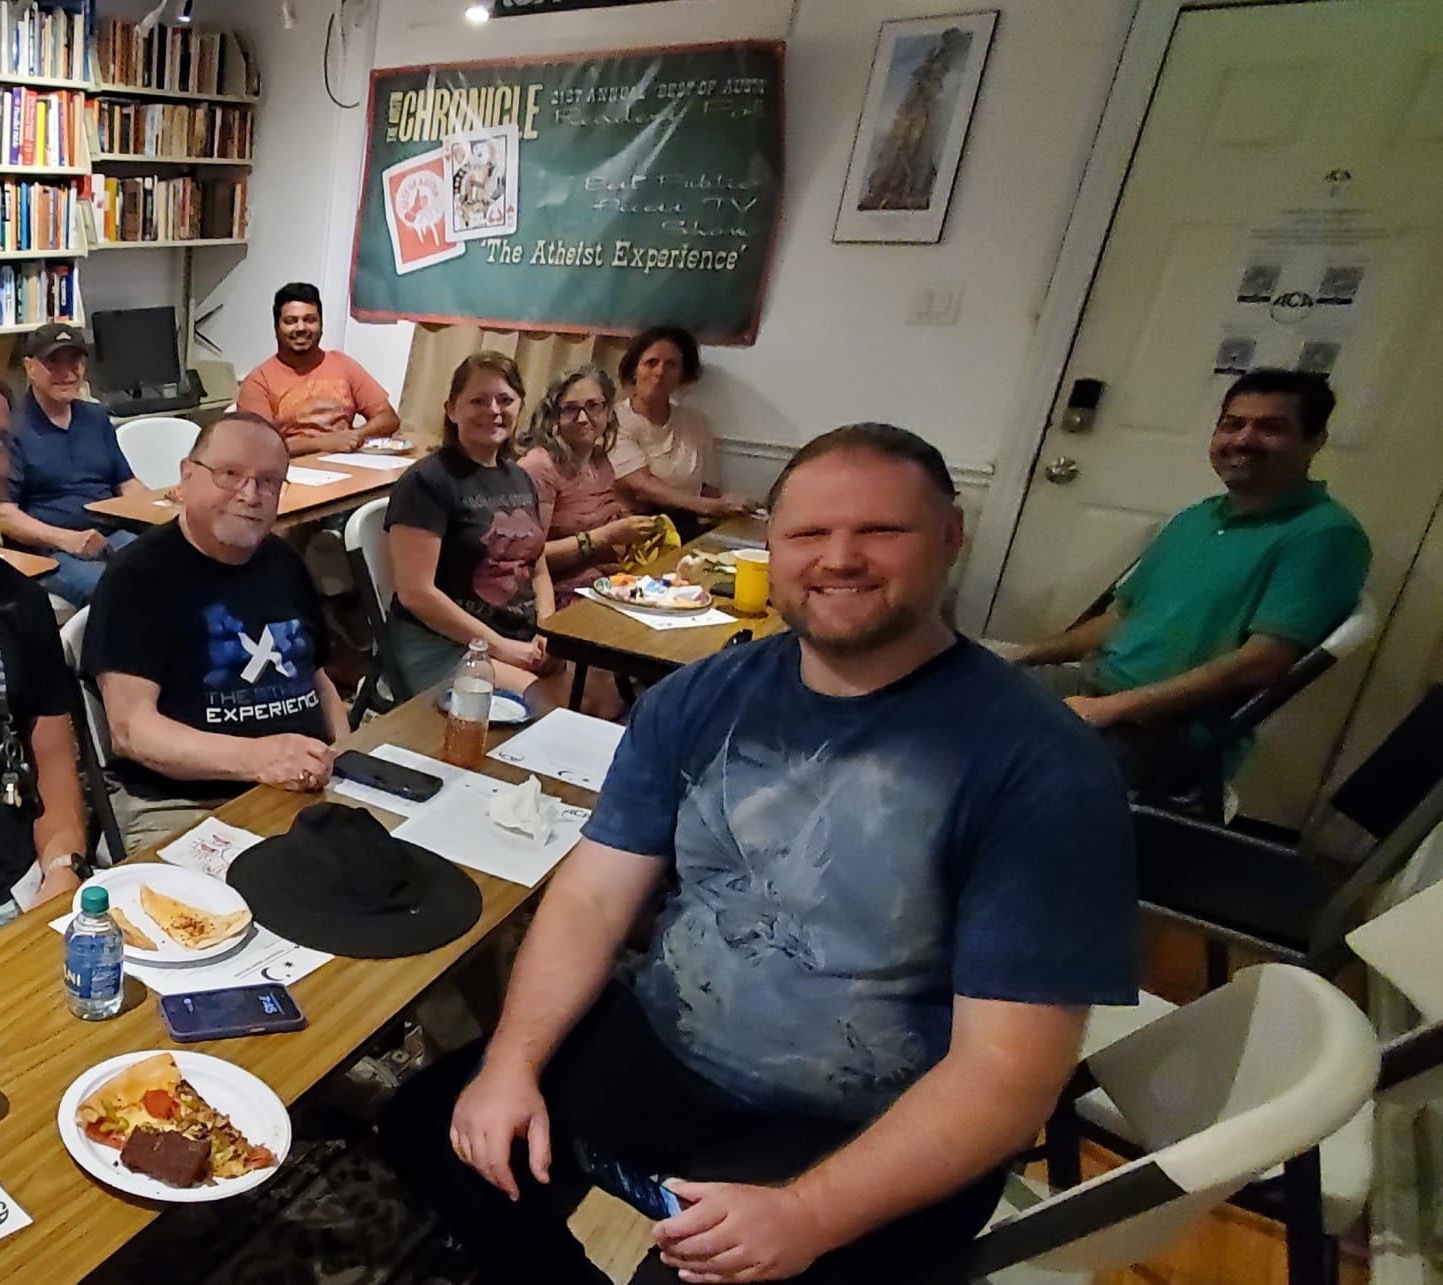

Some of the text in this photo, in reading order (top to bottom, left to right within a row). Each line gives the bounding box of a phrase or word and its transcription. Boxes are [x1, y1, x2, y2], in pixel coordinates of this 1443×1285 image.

[397, 83, 543, 142] CHRONICLE
[530, 239, 603, 266] Atheist
[1272, 291, 1314, 308] ACA
[205, 689, 251, 706] THE
